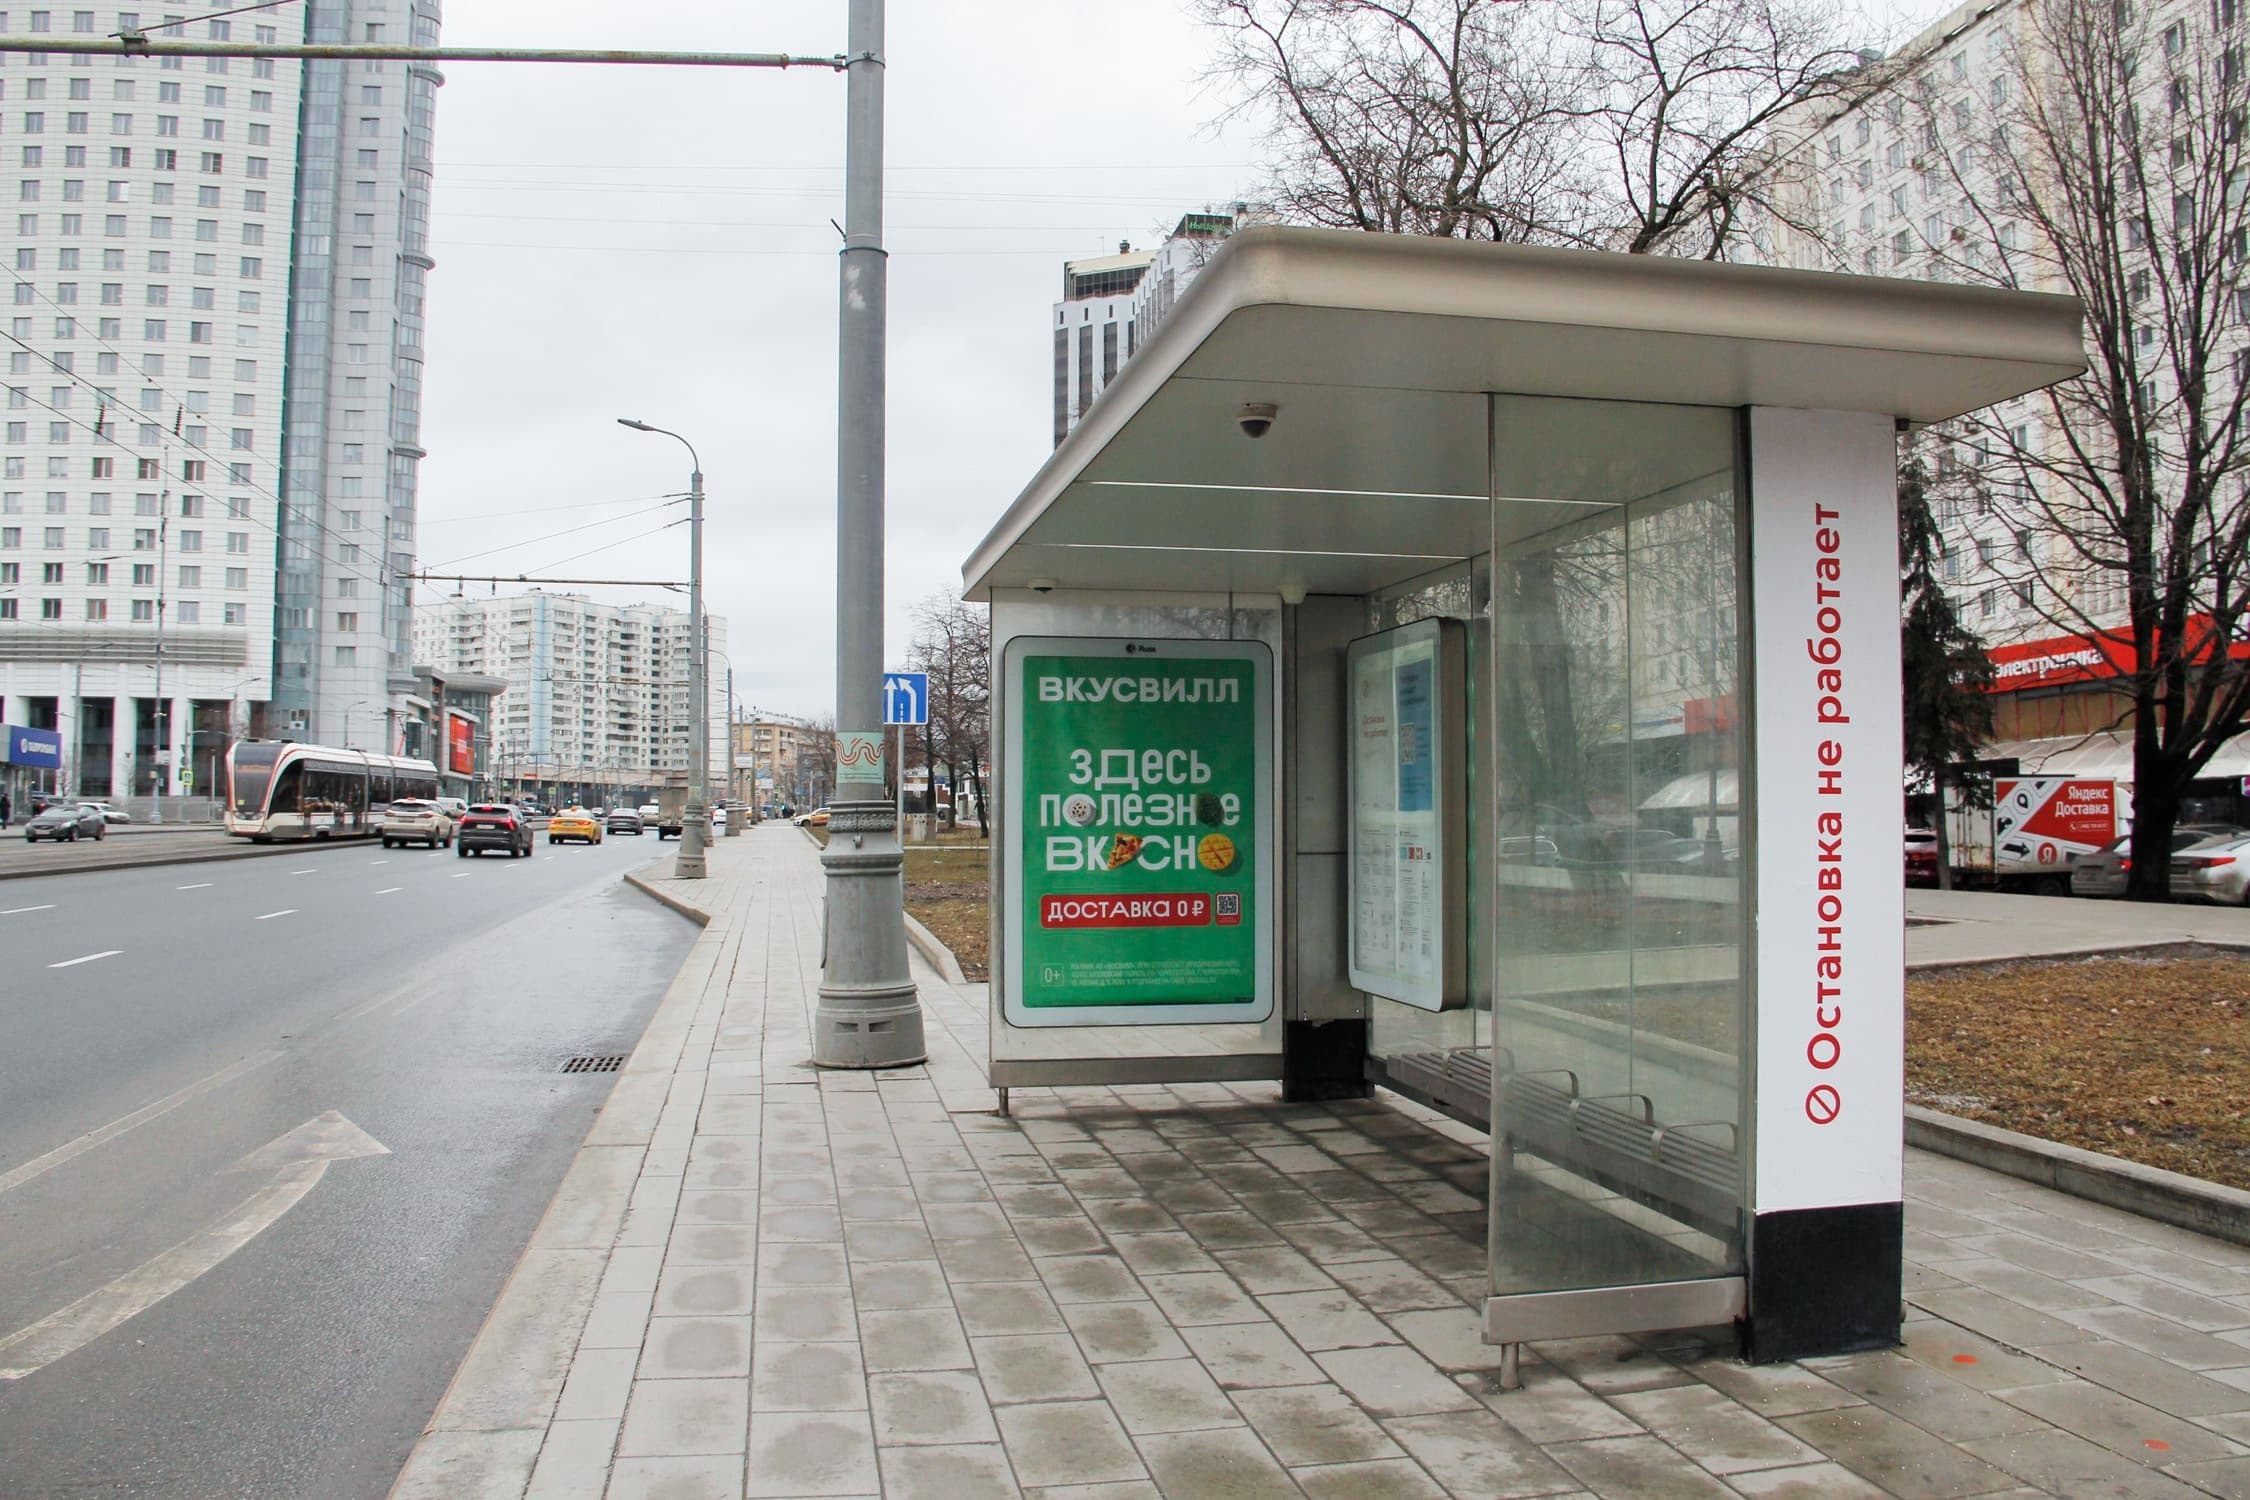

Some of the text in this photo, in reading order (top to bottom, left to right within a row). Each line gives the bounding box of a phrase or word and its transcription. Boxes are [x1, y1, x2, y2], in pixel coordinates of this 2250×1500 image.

[1039, 676, 1239, 704] ВКУСВИЛЛ
[1806, 502, 1849, 1069] Остановка не работает
[2068, 785, 2109, 801] Яндекс
[2055, 801, 2109, 818] Доставка
[1044, 967, 1061, 984] 0+
